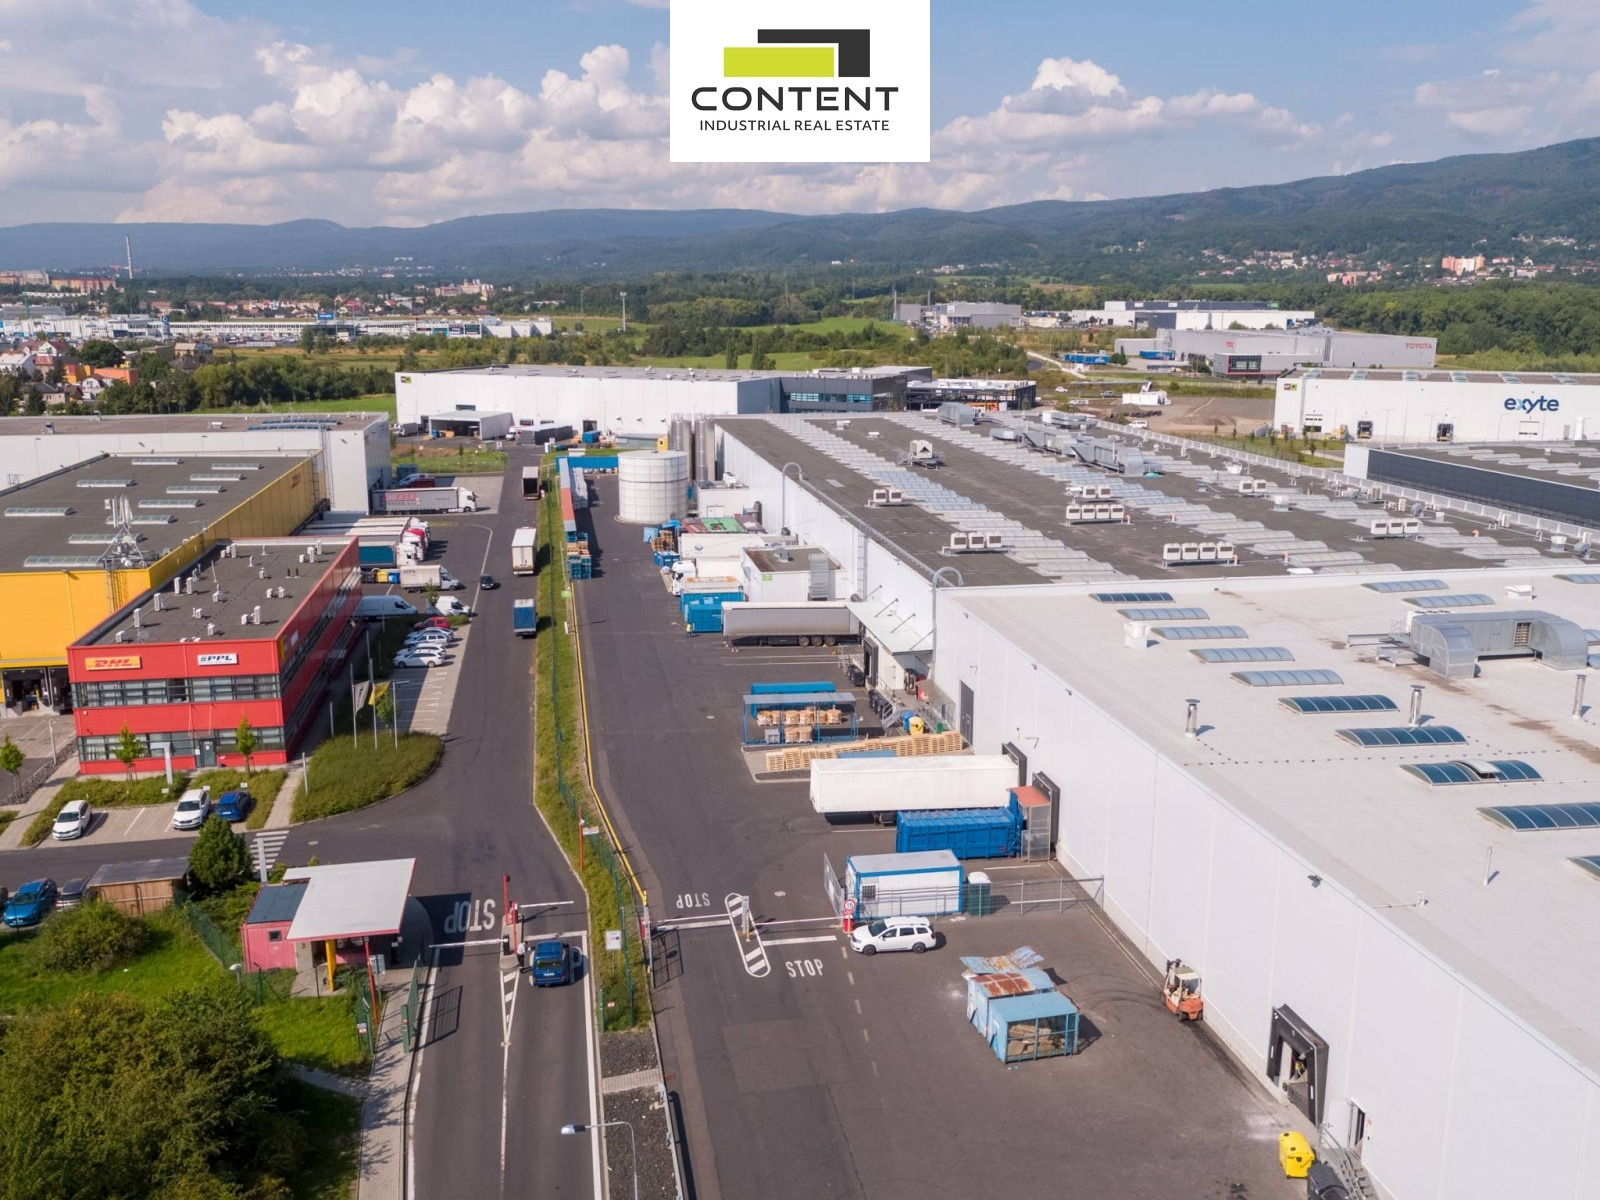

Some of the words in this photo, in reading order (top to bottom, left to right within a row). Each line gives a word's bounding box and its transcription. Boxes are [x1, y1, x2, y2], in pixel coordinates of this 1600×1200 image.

[1504, 395, 1559, 413] exyte
[94, 659, 132, 668] DHL
[676, 892, 711, 909] STOP
[444, 899, 496, 933] STOP
[785, 958, 824, 977] STOP
